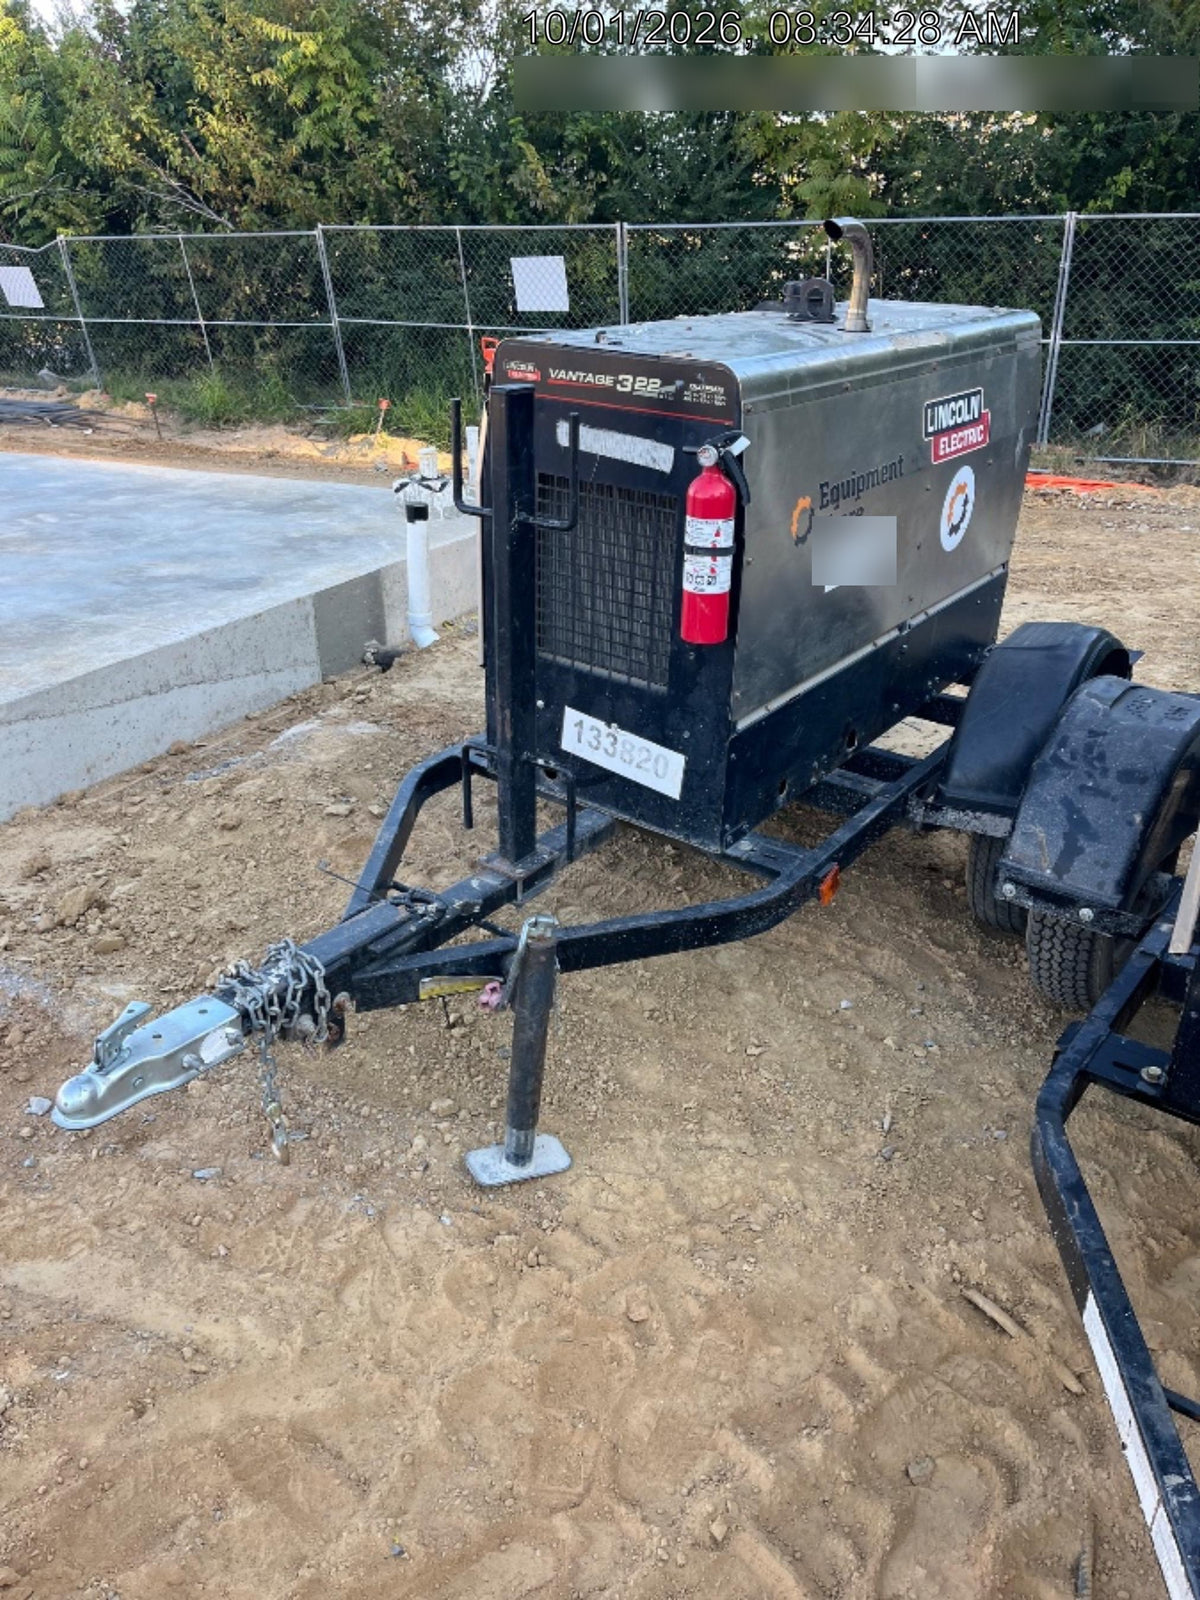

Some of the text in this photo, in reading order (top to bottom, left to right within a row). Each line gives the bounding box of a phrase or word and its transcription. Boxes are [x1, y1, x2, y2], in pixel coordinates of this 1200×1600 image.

[549, 368, 614, 386] VANTAGE
[616, 374, 662, 392] 322
[927, 394, 981, 433] LINCOLN
[939, 425, 984, 456] ELECTRIC
[819, 454, 904, 511] Equipment
[573, 719, 669, 780] 133820
